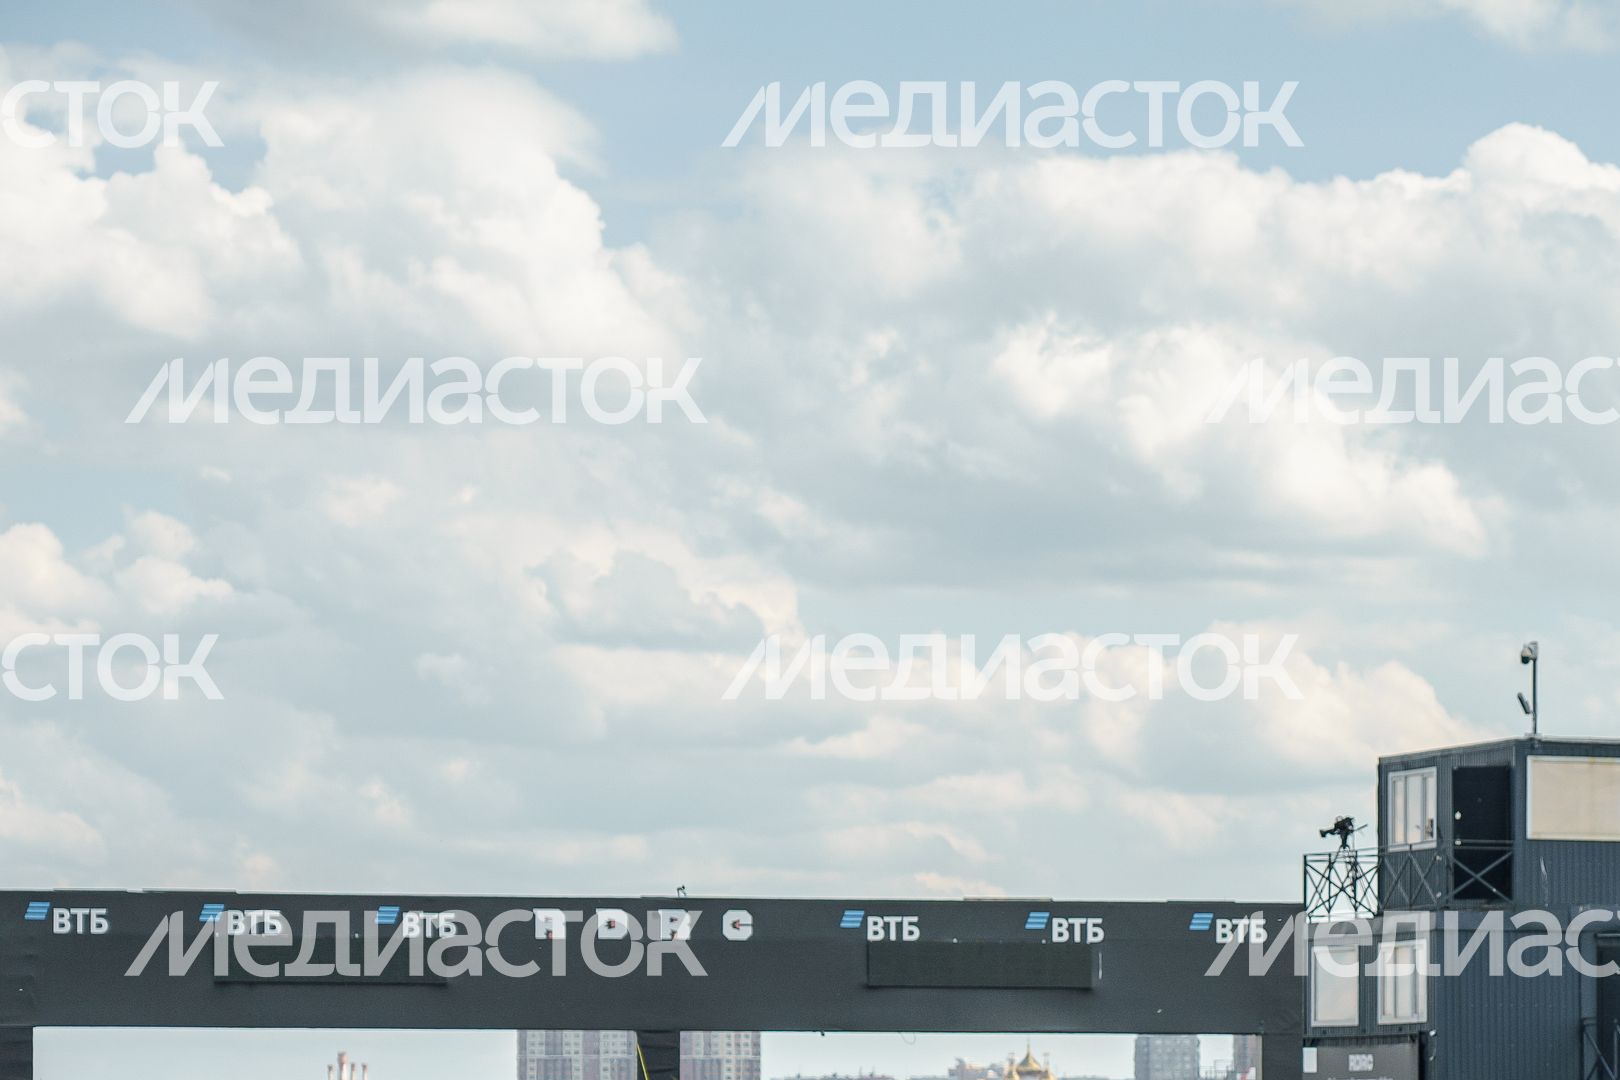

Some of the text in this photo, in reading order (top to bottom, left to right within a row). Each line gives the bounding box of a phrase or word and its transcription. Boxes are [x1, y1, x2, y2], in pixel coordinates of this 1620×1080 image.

[52, 907, 109, 935] ВТБ
[227, 909, 283, 936] ВТБ
[402, 911, 457, 938] ВТБ
[866, 915, 921, 942] ВТБ
[1051, 917, 1105, 944] ВТБ
[1215, 918, 1268, 944] ВТБ
